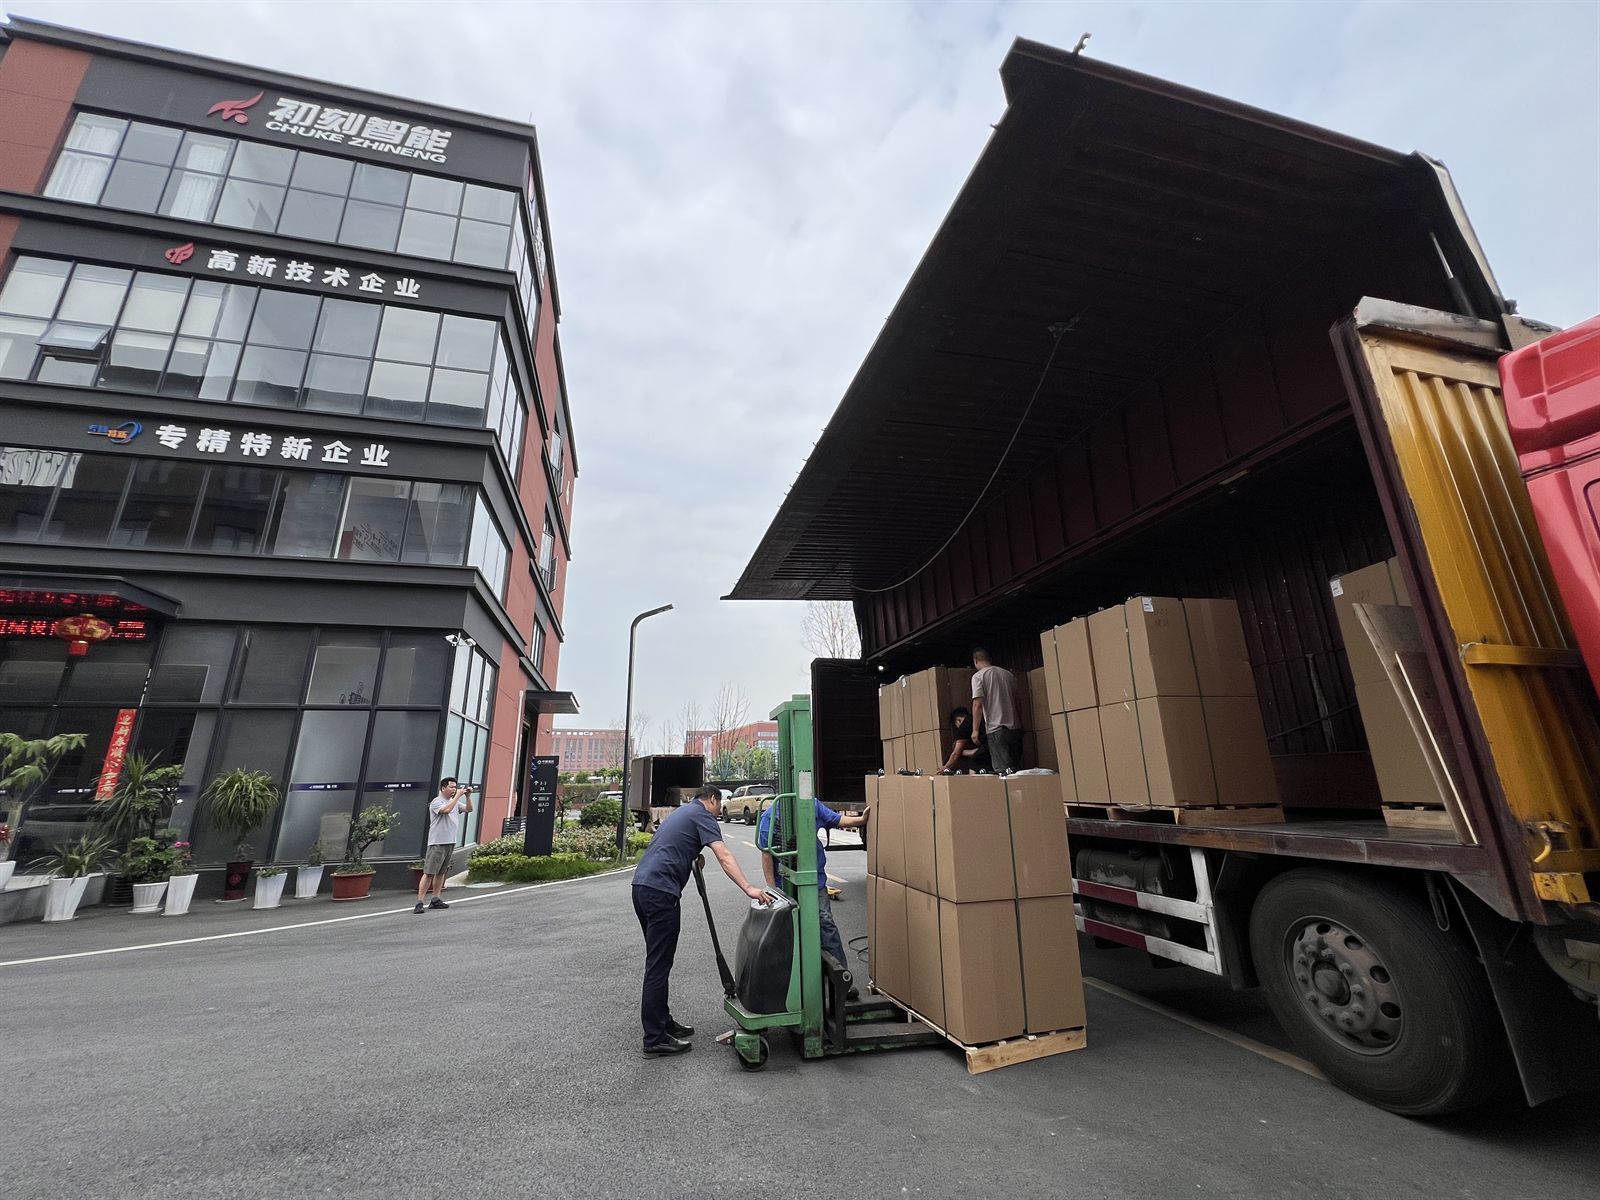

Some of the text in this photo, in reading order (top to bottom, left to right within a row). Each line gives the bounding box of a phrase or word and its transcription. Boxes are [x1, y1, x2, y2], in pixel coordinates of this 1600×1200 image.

[265, 121, 448, 164] CHUKE ZHINENG
[268, 97, 452, 153] 初刻智能
[206, 249, 421, 299] 高新技术企业
[155, 424, 390, 467] 专精特新企业
